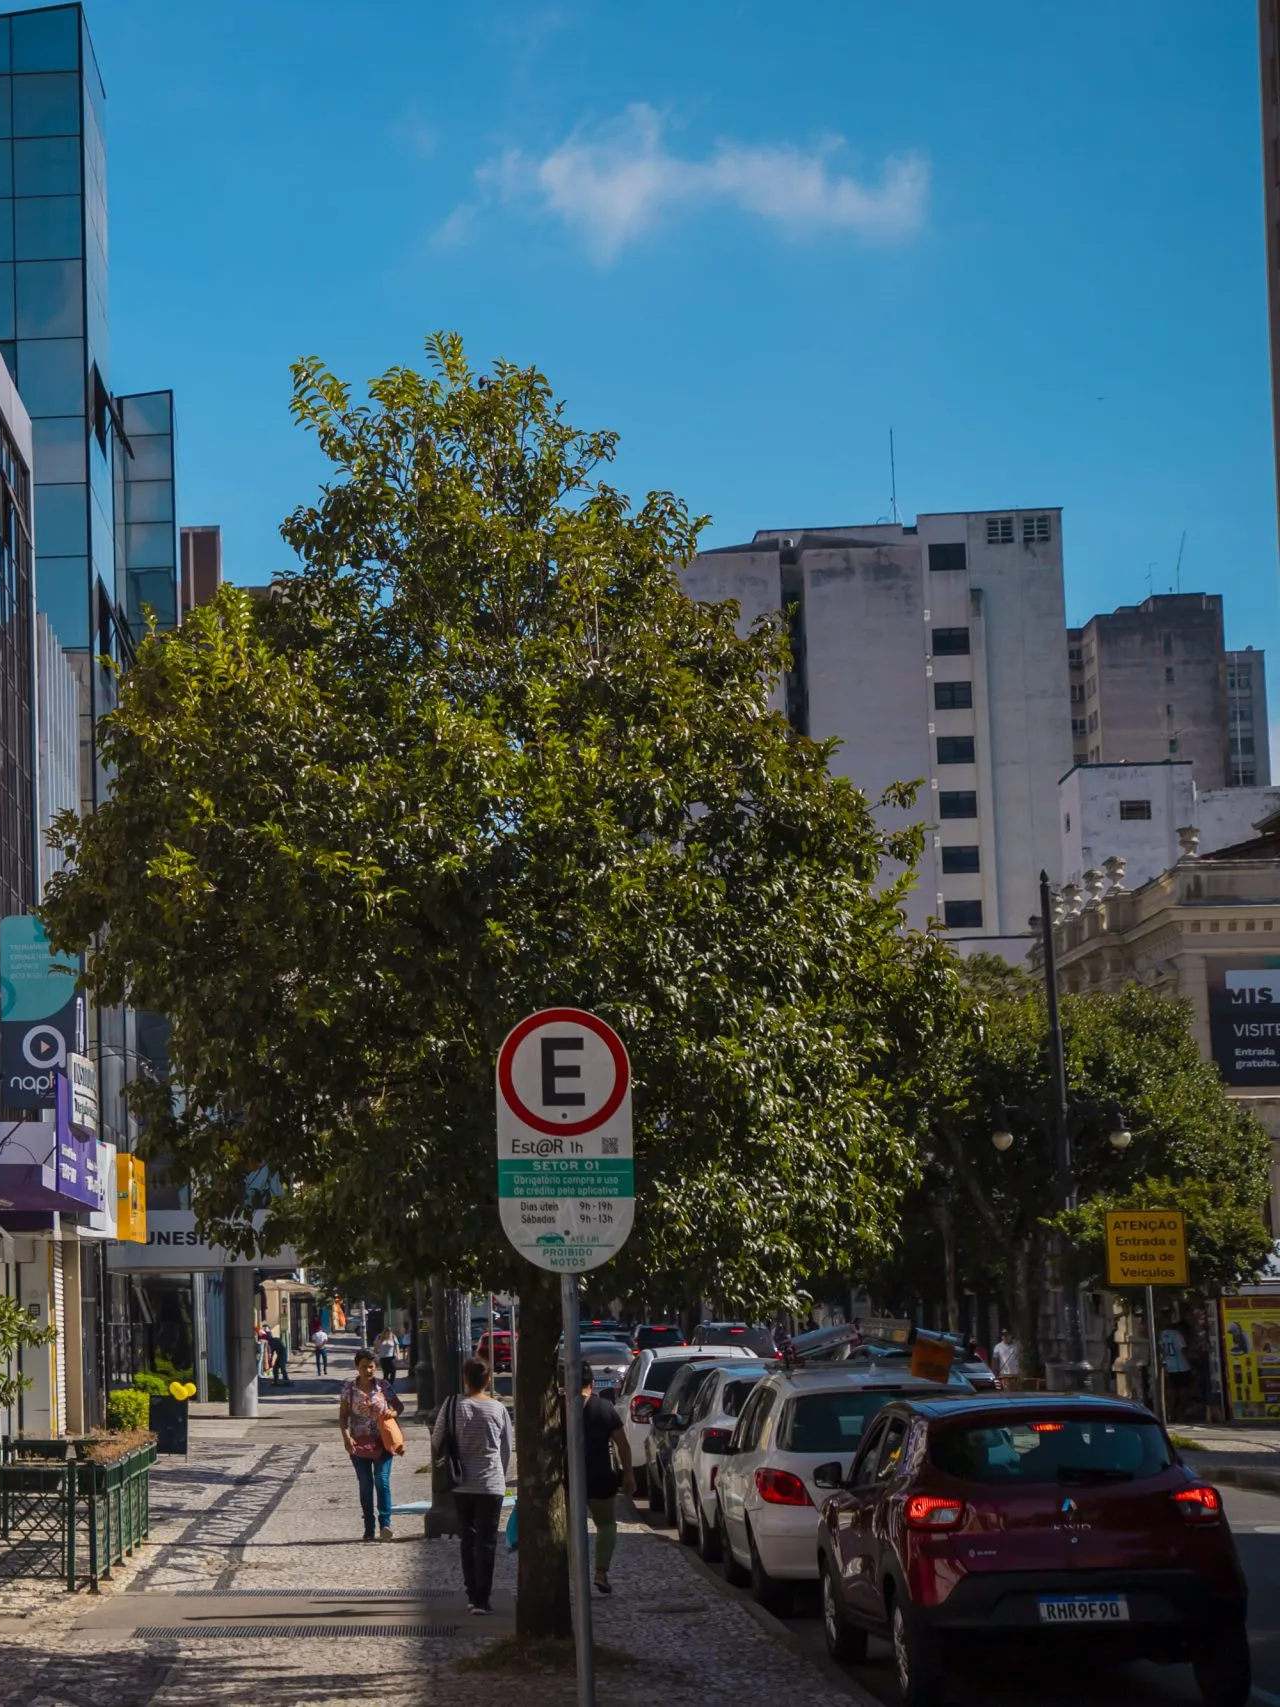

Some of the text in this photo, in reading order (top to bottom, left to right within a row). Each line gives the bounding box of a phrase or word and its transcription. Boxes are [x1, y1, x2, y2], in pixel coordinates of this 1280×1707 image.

[1229, 987, 1273, 1004] MIS
[1233, 1023, 1280, 1037] VISITE
[1234, 1048, 1275, 1057] Entrada
[1235, 1059, 1279, 1070] gratuita.
[541, 1037, 585, 1106] E
[10, 1070, 56, 1095] napt
[511, 1139, 583, 1157] Est@R 1h
[532, 1161, 579, 1171] SETOR
[513, 1175, 619, 1186] Obrigatório compra e uso
[513, 1186, 524, 1195] de
[557, 1187, 576, 1197] pelo
[577, 1187, 619, 1197] aplicativo
[520, 1201, 538, 1211] Dias
[539, 1201, 559, 1211] úteis
[579, 1202, 591, 1211] 9h
[598, 1201, 613, 1211] 19h
[521, 1214, 556, 1224] Sábados
[579, 1214, 591, 1224] 9h
[598, 1214, 614, 1224] 13h
[1112, 1218, 1178, 1233] ATENÇÃO
[1115, 1236, 1177, 1246] Entrada e
[542, 1248, 593, 1257] PROIBIDO
[1159, 1251, 1176, 1262] de
[550, 1258, 586, 1267] MOTOS
